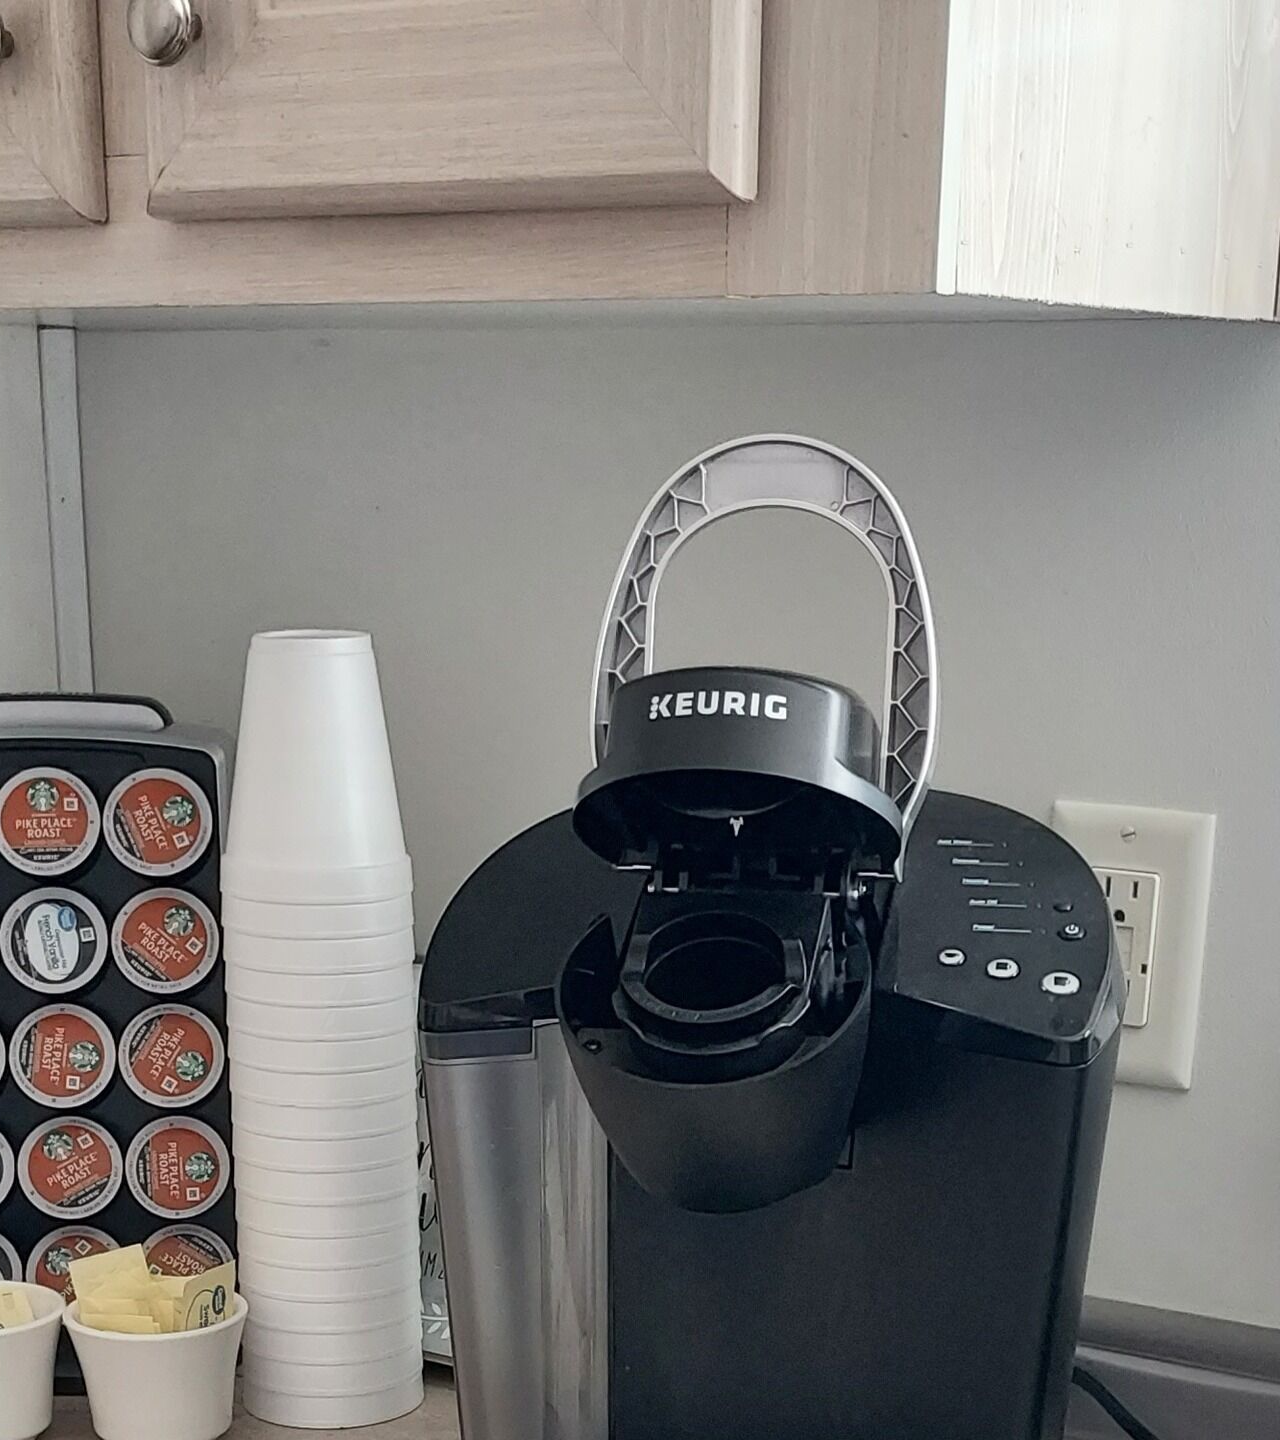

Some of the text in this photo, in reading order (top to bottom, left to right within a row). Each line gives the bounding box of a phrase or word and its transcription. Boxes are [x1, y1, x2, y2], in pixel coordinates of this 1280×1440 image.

[649, 690, 788, 720] KEURIG
[16, 819, 72, 828] PIKE PLACE
[27, 828, 61, 838] ROAST
[132, 808, 153, 843] ROAST
[138, 794, 167, 850] PIKE PLACE
[137, 922, 185, 963] PIKE PLACE
[139, 935, 170, 963] ROAST
[41, 1036, 53, 1069] ROAST
[50, 1027, 65, 1081] PIKE PLACE
[146, 1031, 170, 1064] ROAST
[148, 1027, 184, 1078] PIKE PLACE
[46, 1152, 97, 1186] PIKE PLACE
[60, 1165, 92, 1189] ROAST
[158, 1152, 169, 1185] ROAST
[168, 1141, 178, 1197] PIKE PLACE
[174, 1250, 206, 1275] ROAST
